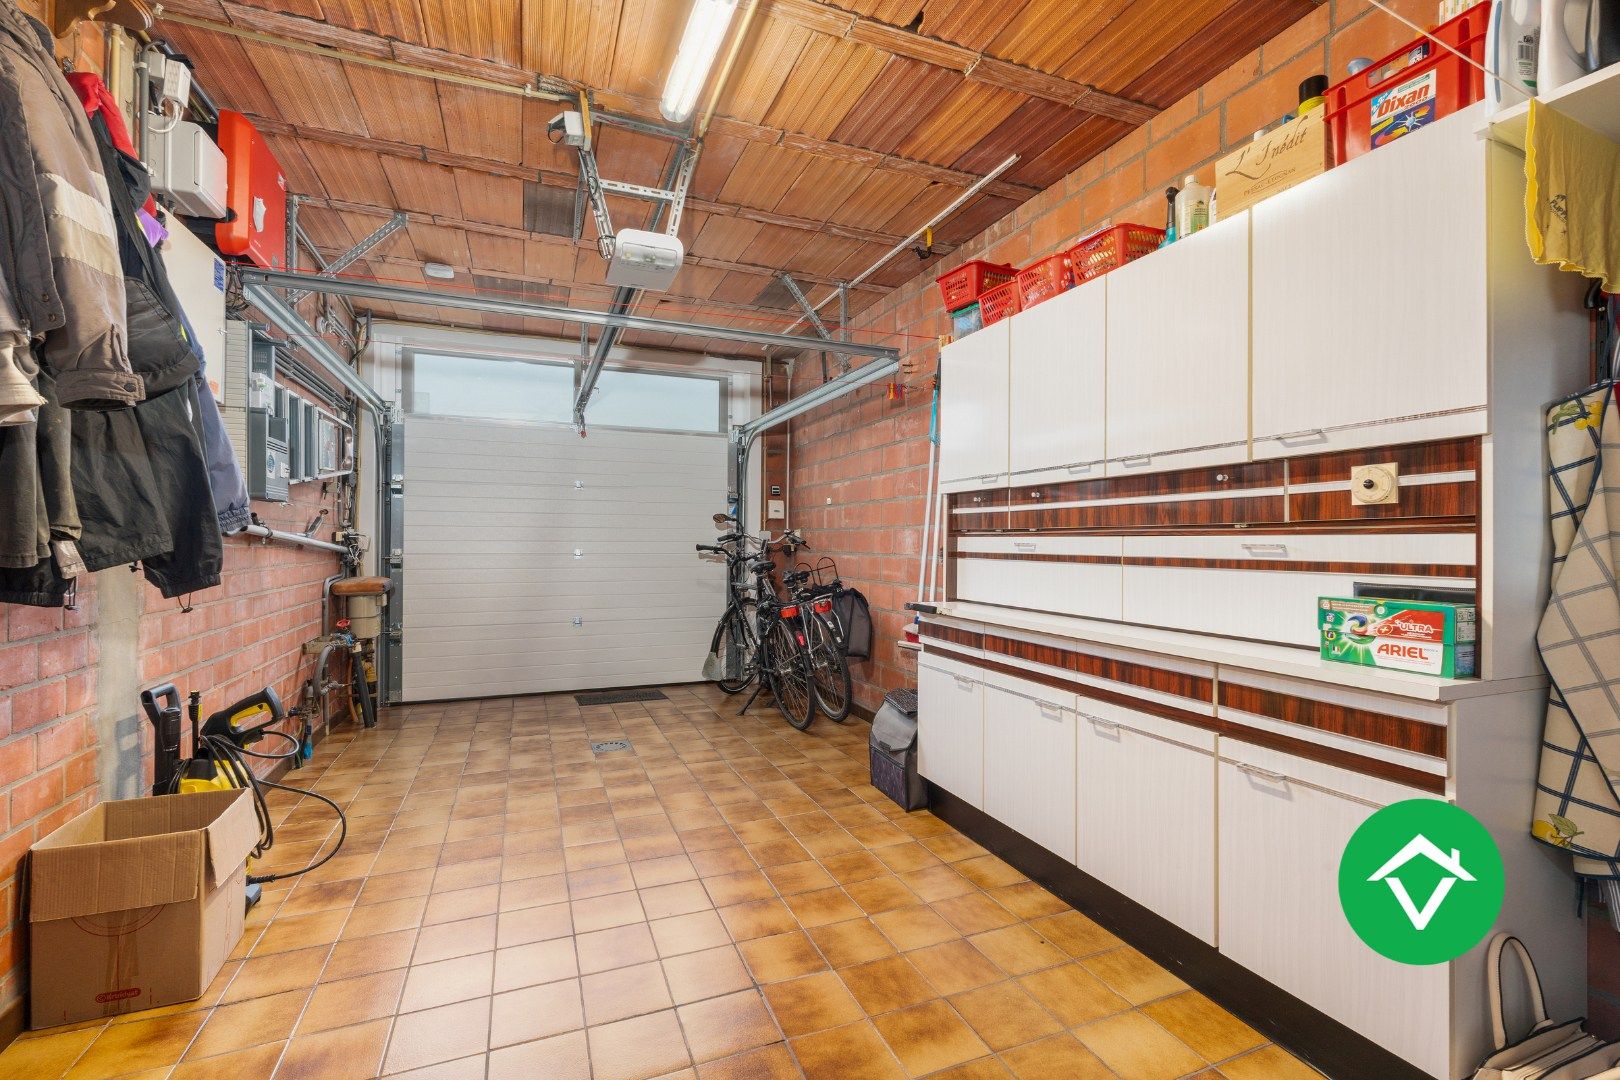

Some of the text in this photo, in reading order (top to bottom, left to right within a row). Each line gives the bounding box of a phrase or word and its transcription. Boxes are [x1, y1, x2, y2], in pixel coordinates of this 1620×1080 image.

[1377, 84, 1430, 119] Dixan
[1400, 623, 1434, 634] ULTRA
[1377, 643, 1429, 661] ARIEL
